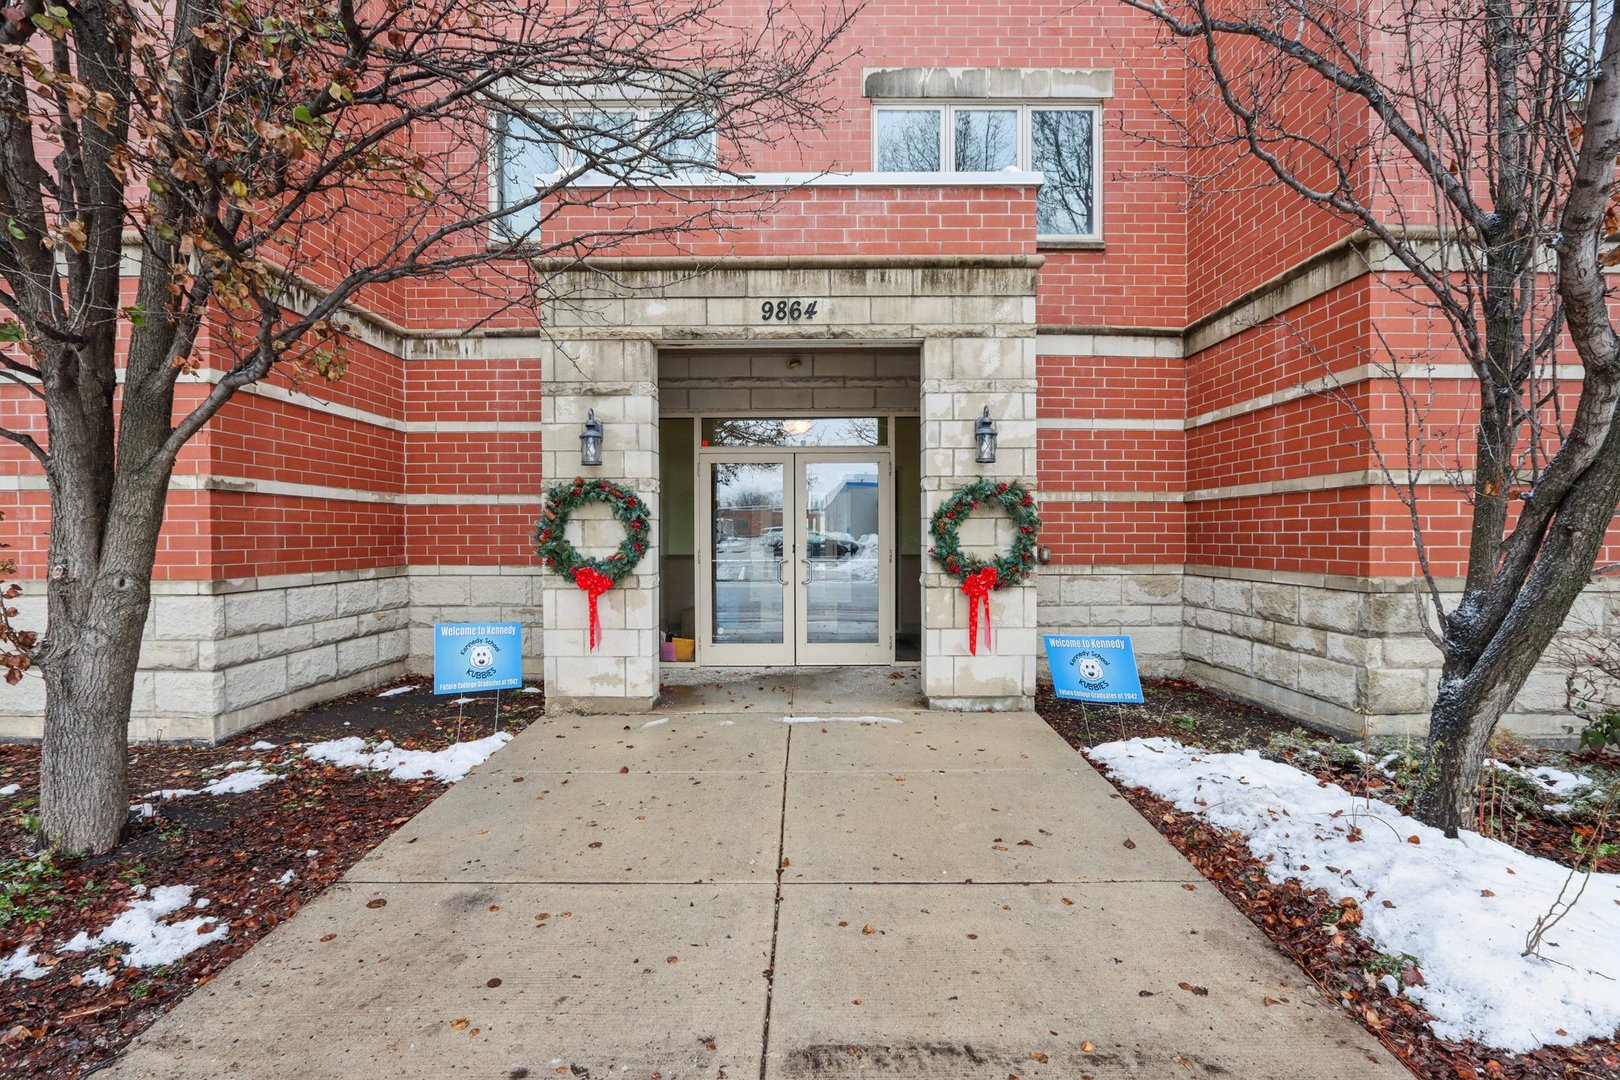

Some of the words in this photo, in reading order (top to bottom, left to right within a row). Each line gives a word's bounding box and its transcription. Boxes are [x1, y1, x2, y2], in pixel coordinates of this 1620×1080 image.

[762, 300, 818, 320] 9864
[441, 626, 476, 636] Welcome
[478, 626, 485, 635] to
[486, 626, 516, 635] Kennedy
[460, 638, 483, 656] Kennedy
[485, 638, 501, 652] School
[1049, 638, 1081, 648] Welcome
[1082, 639, 1090, 648] to
[1091, 639, 1124, 649] Kennedy
[1069, 650, 1089, 666] Kennedy
[1091, 651, 1110, 666] School
[466, 667, 496, 679] KUBBIES
[1078, 678, 1109, 691] KUBBIES
